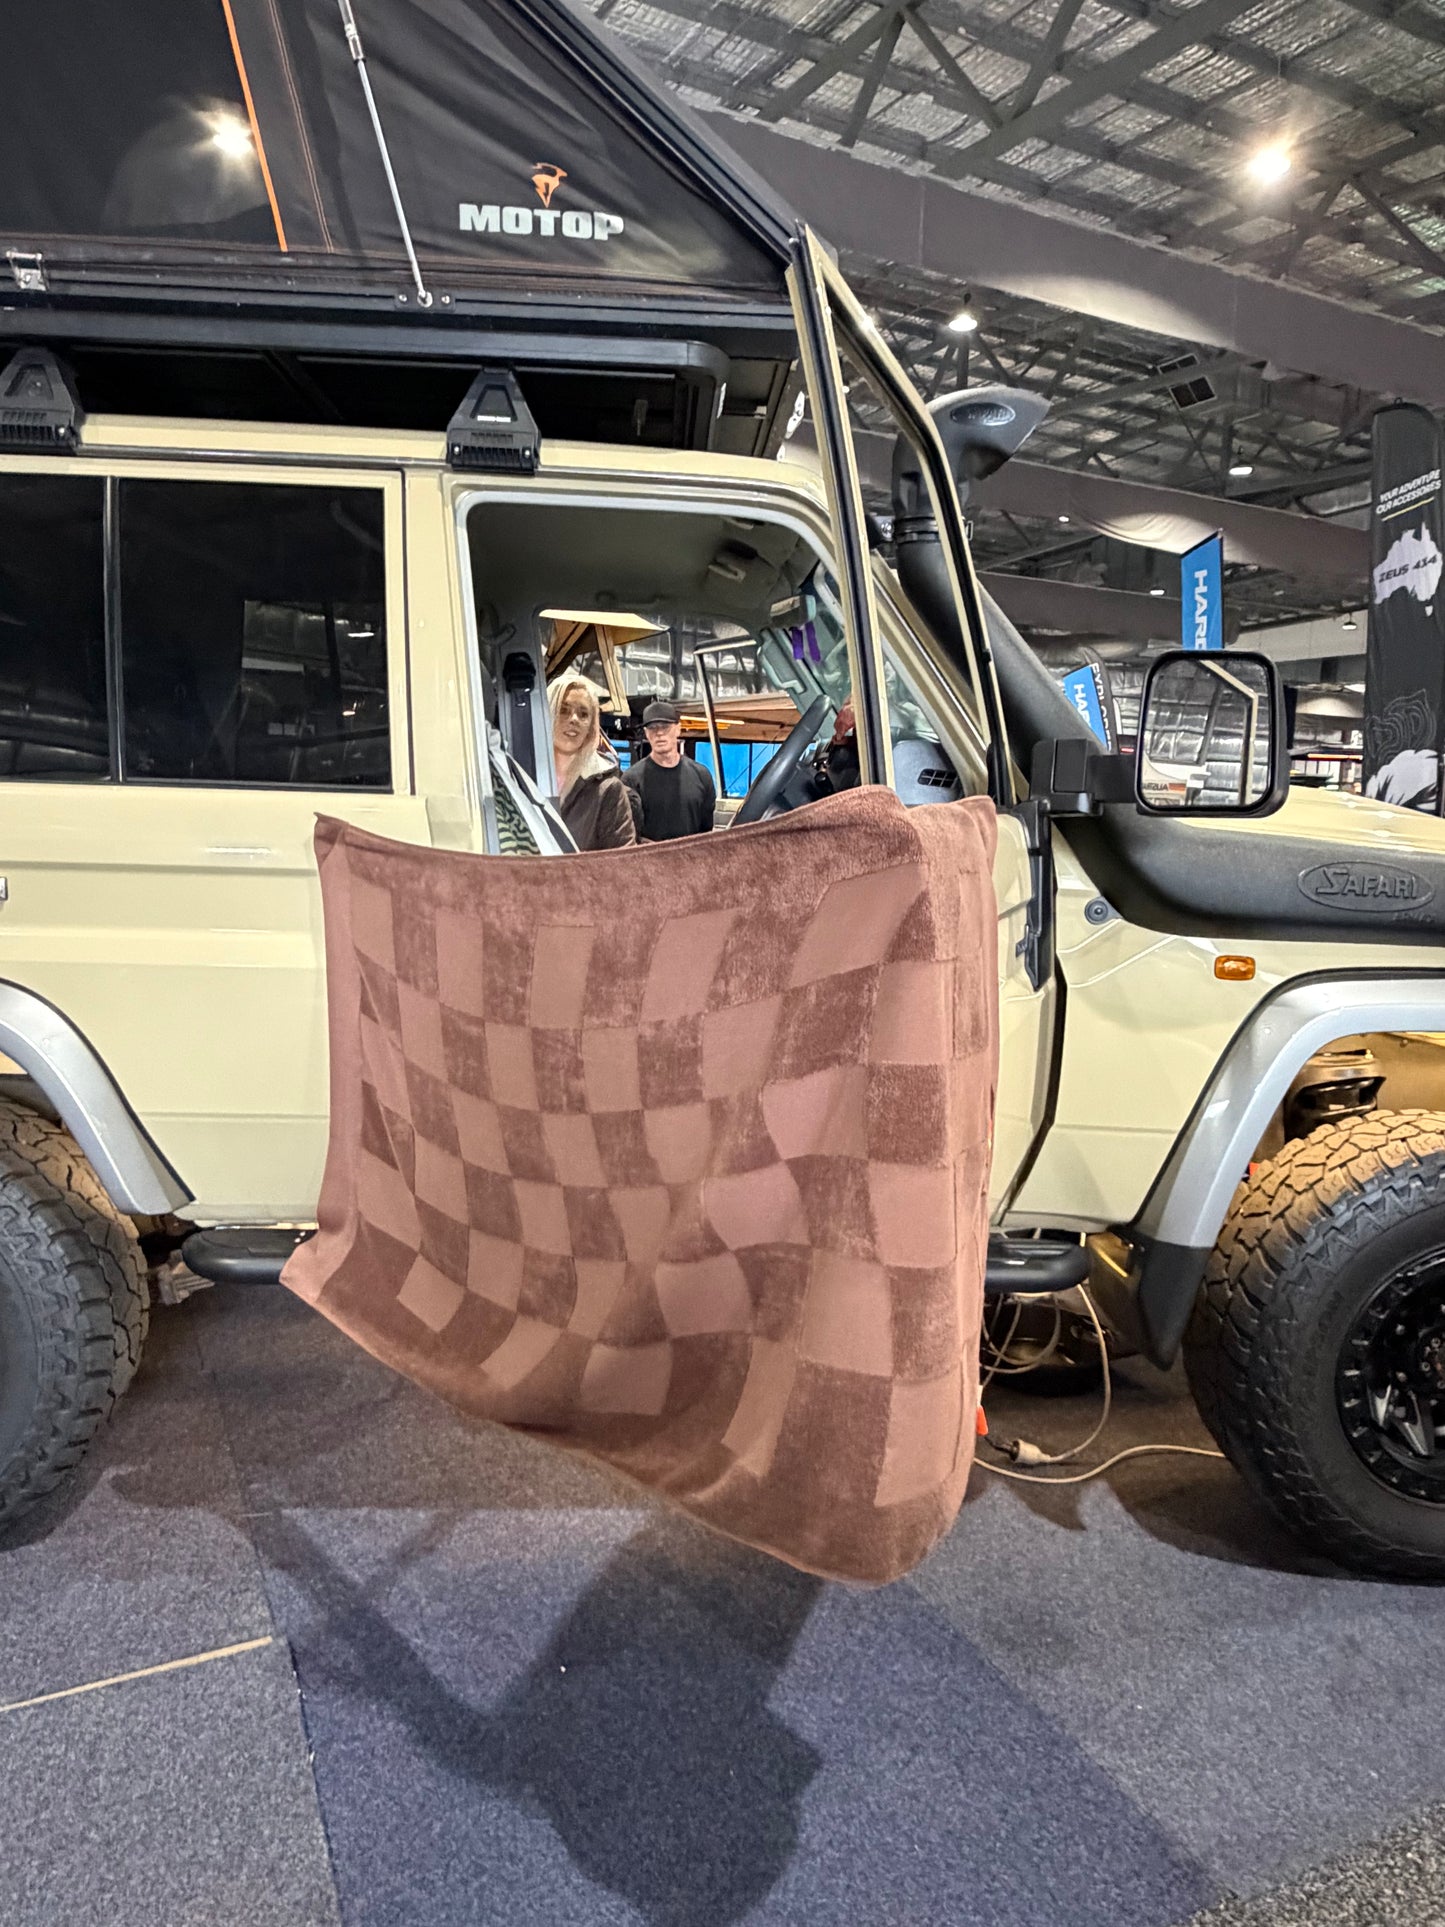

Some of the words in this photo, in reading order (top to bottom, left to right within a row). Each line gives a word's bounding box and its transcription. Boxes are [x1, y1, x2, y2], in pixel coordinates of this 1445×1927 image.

[459, 203, 624, 241] MOTOP
[1376, 501, 1393, 514] OUR
[1393, 480, 1442, 508] ACCESSORIES
[1399, 469, 1440, 495] ADVENTURE
[1379, 563, 1410, 583] ZEUS
[1315, 866, 1418, 900] SAFARI
